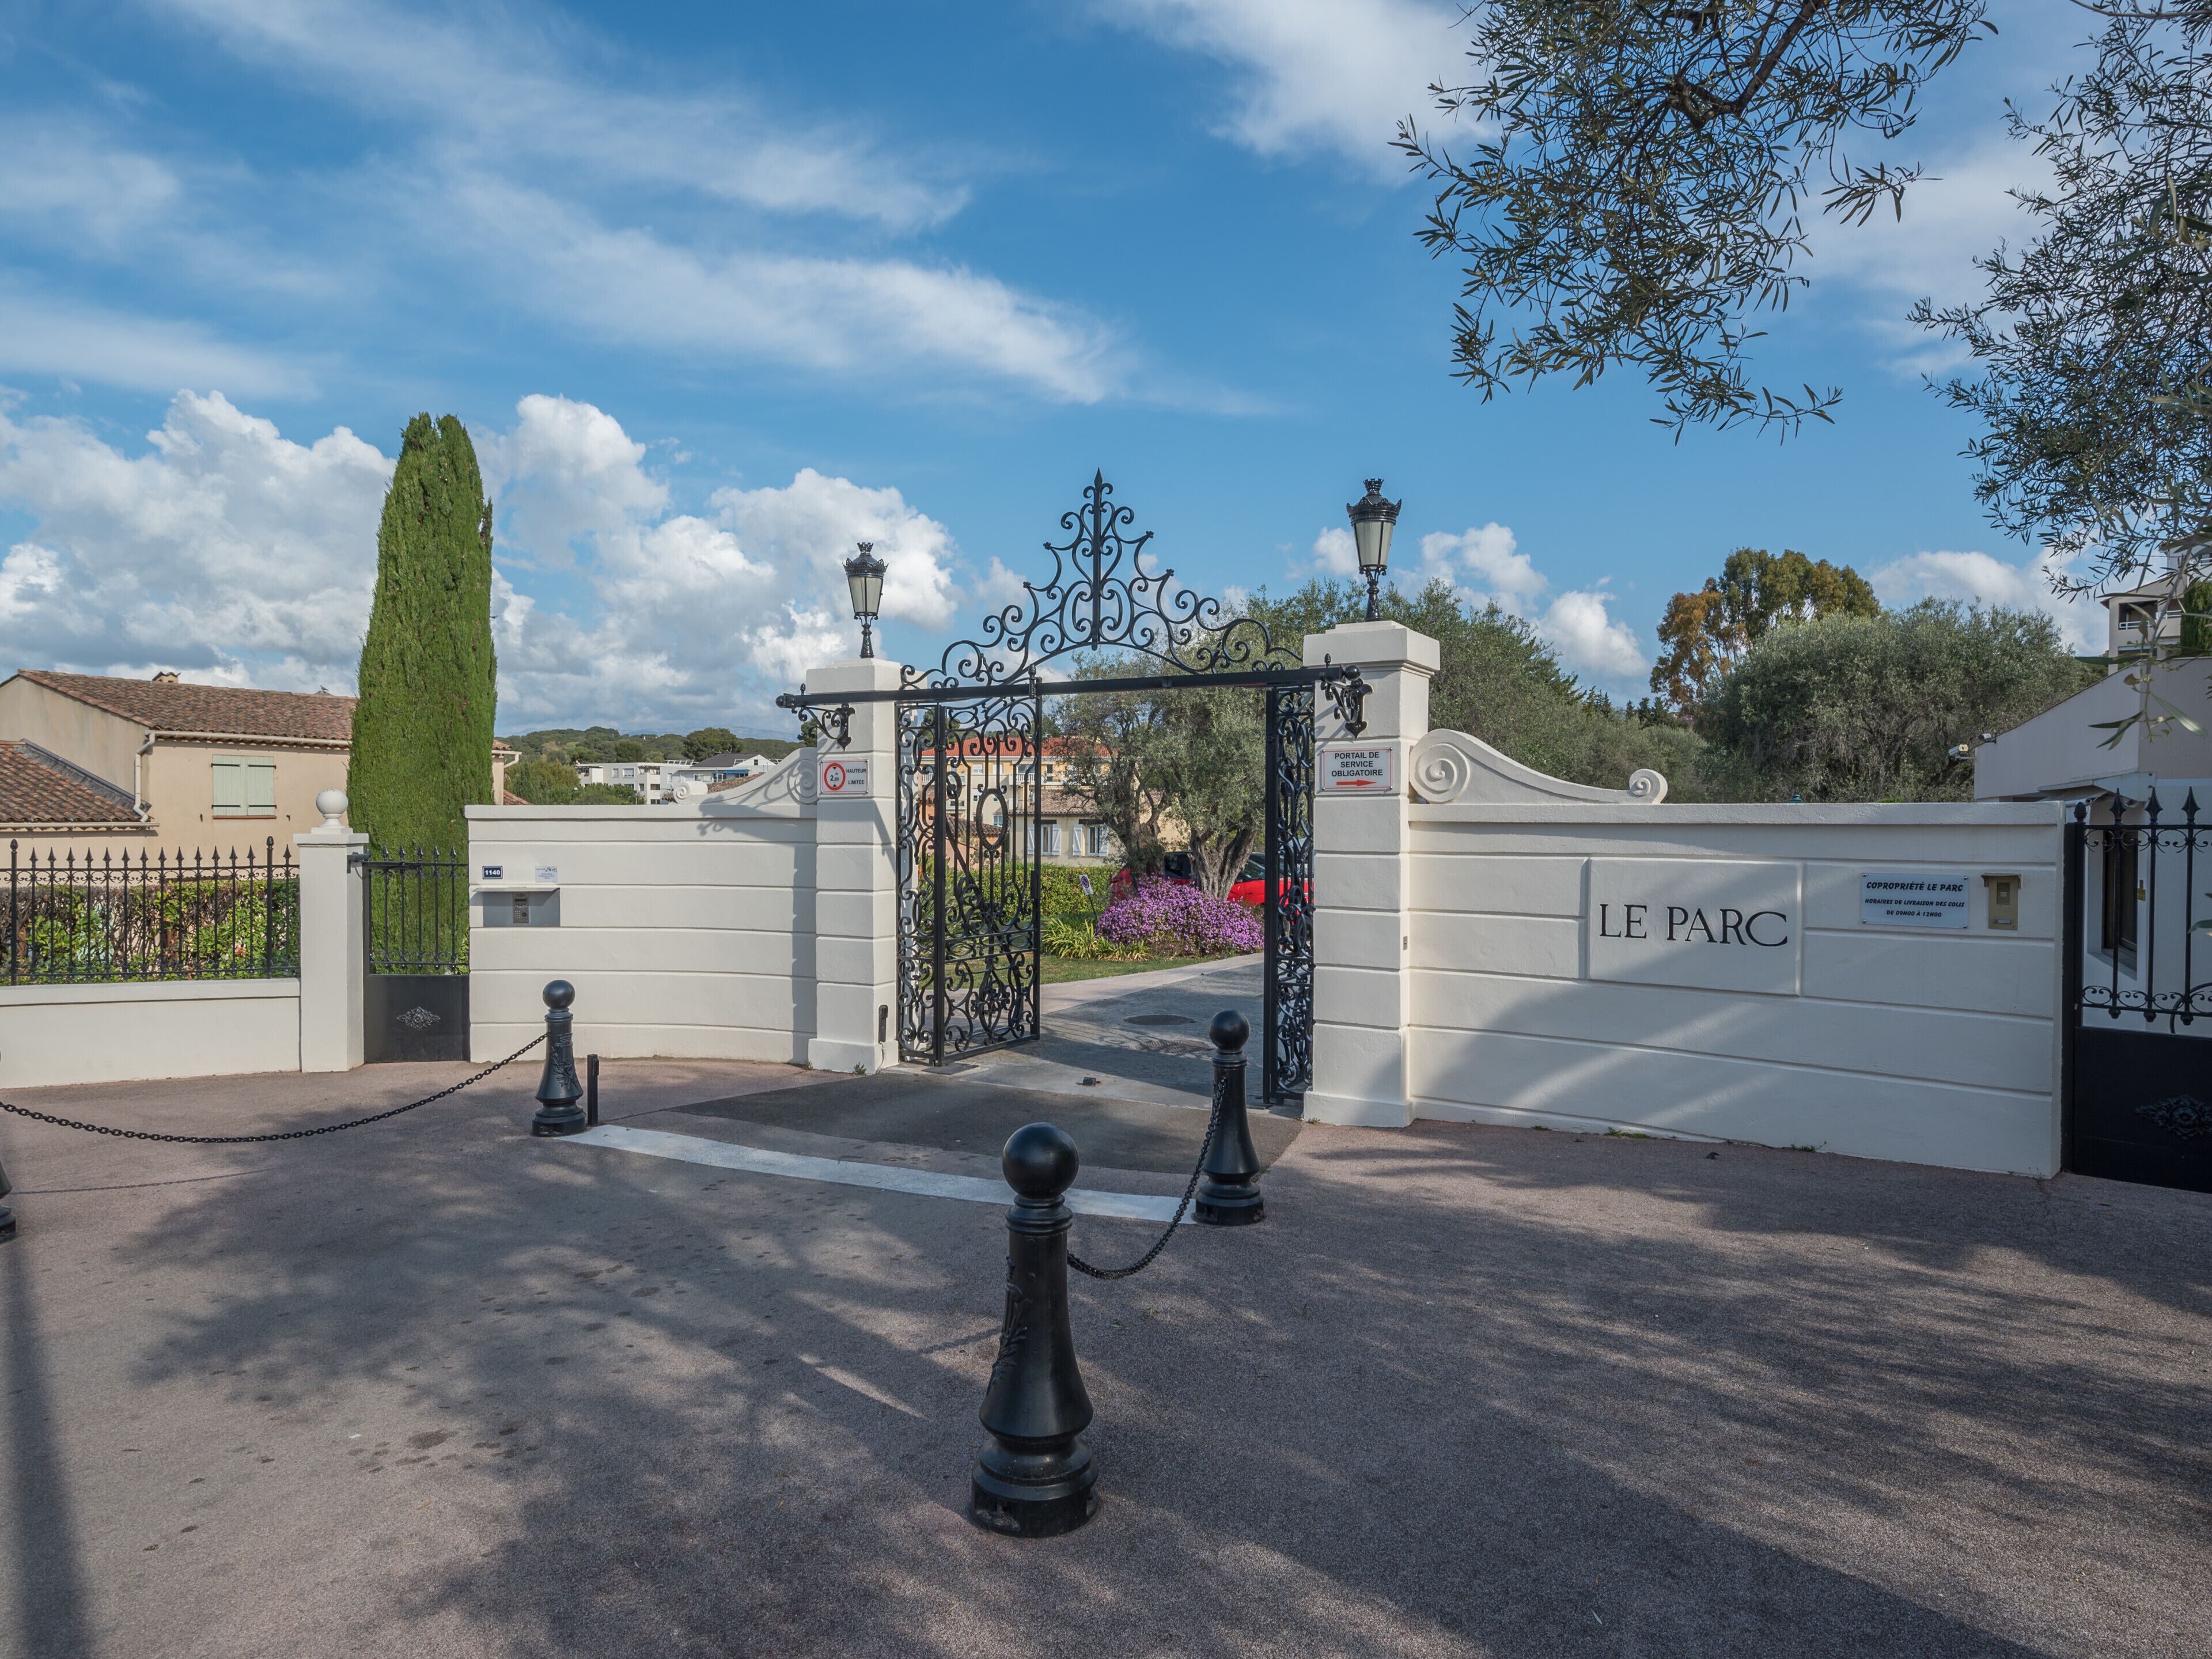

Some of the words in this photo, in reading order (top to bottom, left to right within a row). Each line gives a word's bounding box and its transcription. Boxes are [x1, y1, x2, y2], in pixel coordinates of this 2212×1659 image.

[1866, 881, 1925, 891] COPROPRIÉTÉ
[1599, 904, 1647, 939] LE
[1666, 906, 1788, 946] PARC
